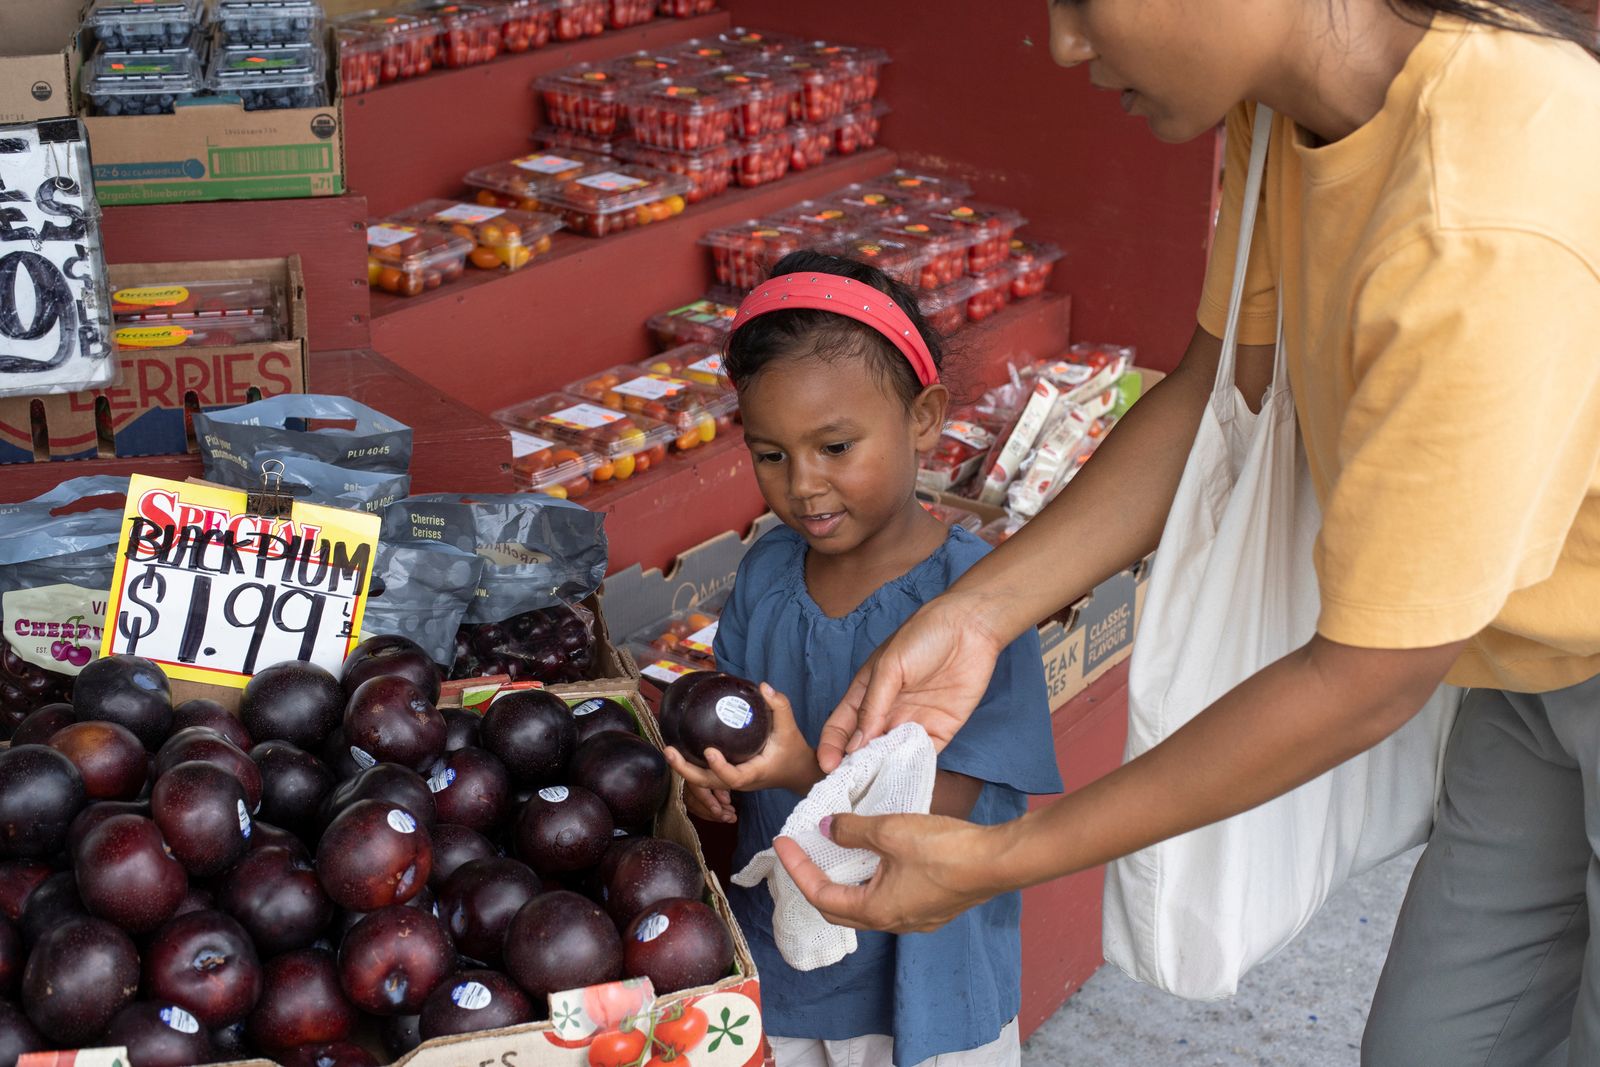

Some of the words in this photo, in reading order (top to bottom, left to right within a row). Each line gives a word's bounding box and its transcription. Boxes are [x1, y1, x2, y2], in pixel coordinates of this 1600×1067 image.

[96, 168, 119, 178] 12-6
[98, 191, 140, 202] Organic
[143, 189, 203, 199] Blueberries
[347, 449, 365, 460] PLU
[366, 446, 391, 456] 4045
[130, 489, 322, 559] SPECIAL
[411, 513, 445, 526] Cherries
[412, 526, 442, 539] Cerises
[119, 565, 327, 675] $1.99
[15, 619, 105, 640] CHERRI
[36, 646, 48, 655] EST.
[1089, 628, 1126, 665] FLAVOUR
